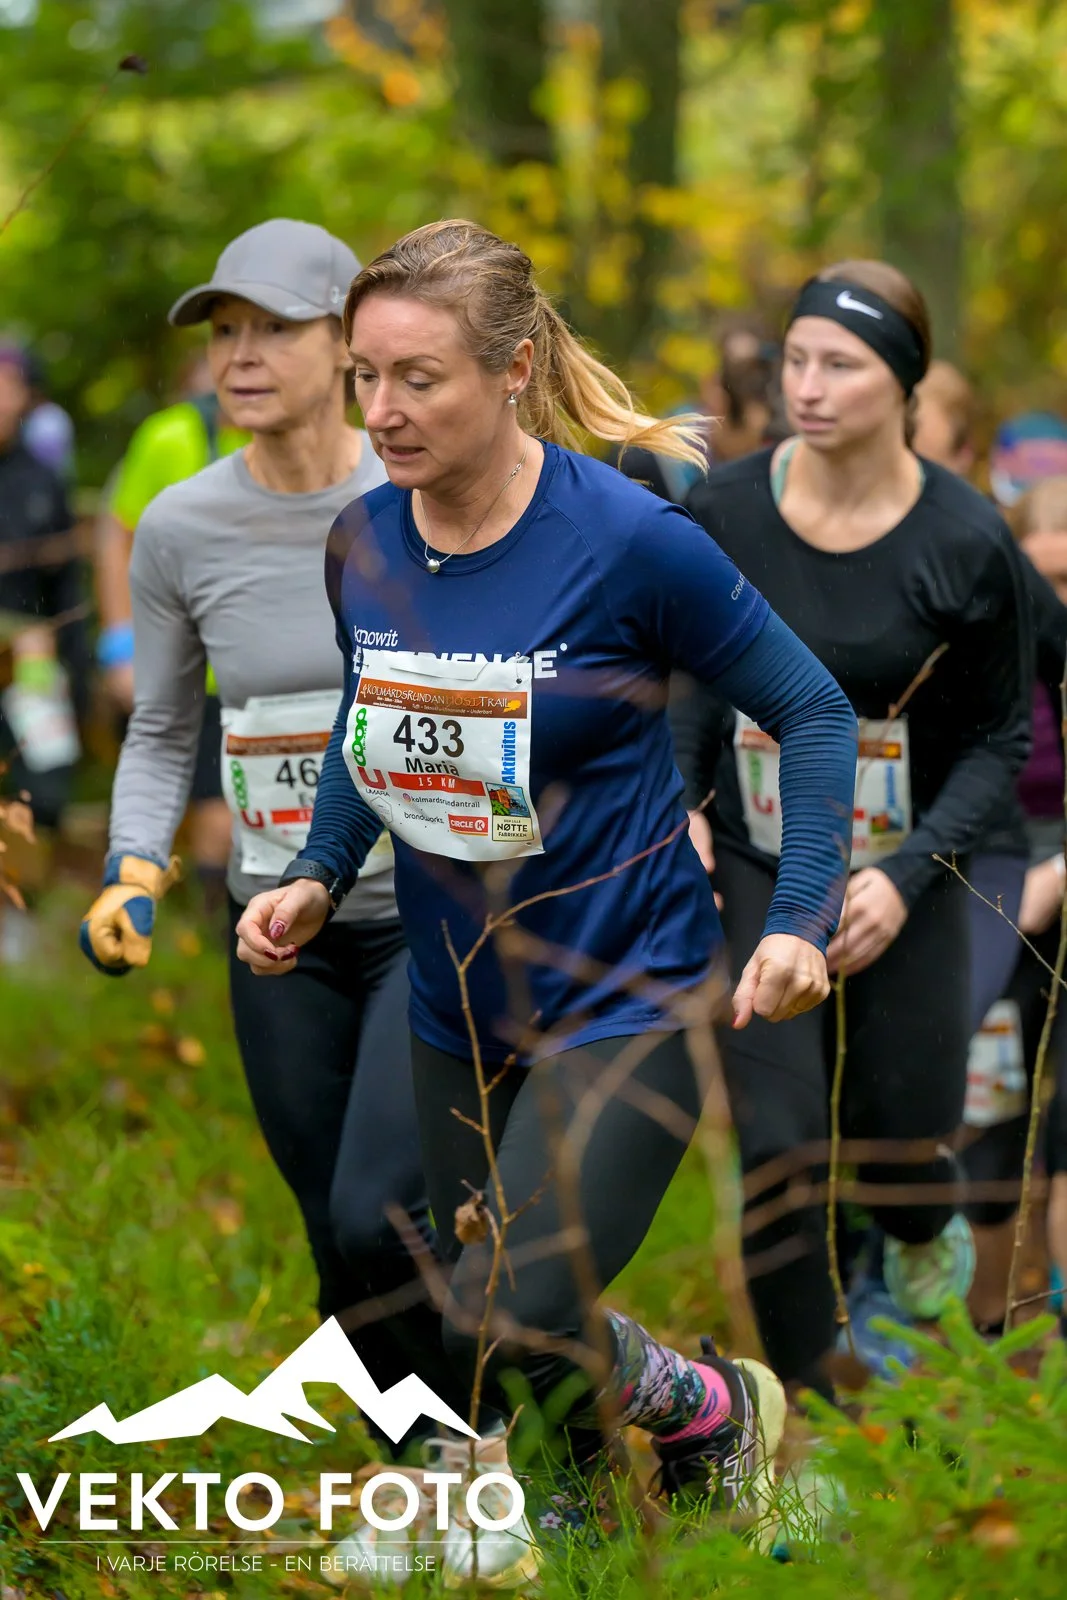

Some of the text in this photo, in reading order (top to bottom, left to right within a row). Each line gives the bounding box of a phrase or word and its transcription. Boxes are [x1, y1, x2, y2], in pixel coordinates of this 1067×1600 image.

[354, 625, 398, 647] knowit
[393, 714, 465, 758] 433
[502, 721, 516, 785] Aktivitus
[275, 758, 320, 788] 46
[405, 757, 459, 776] Maria
[450, 819, 474, 829] CIRCLE
[497, 823, 528, 832] NØTTE
